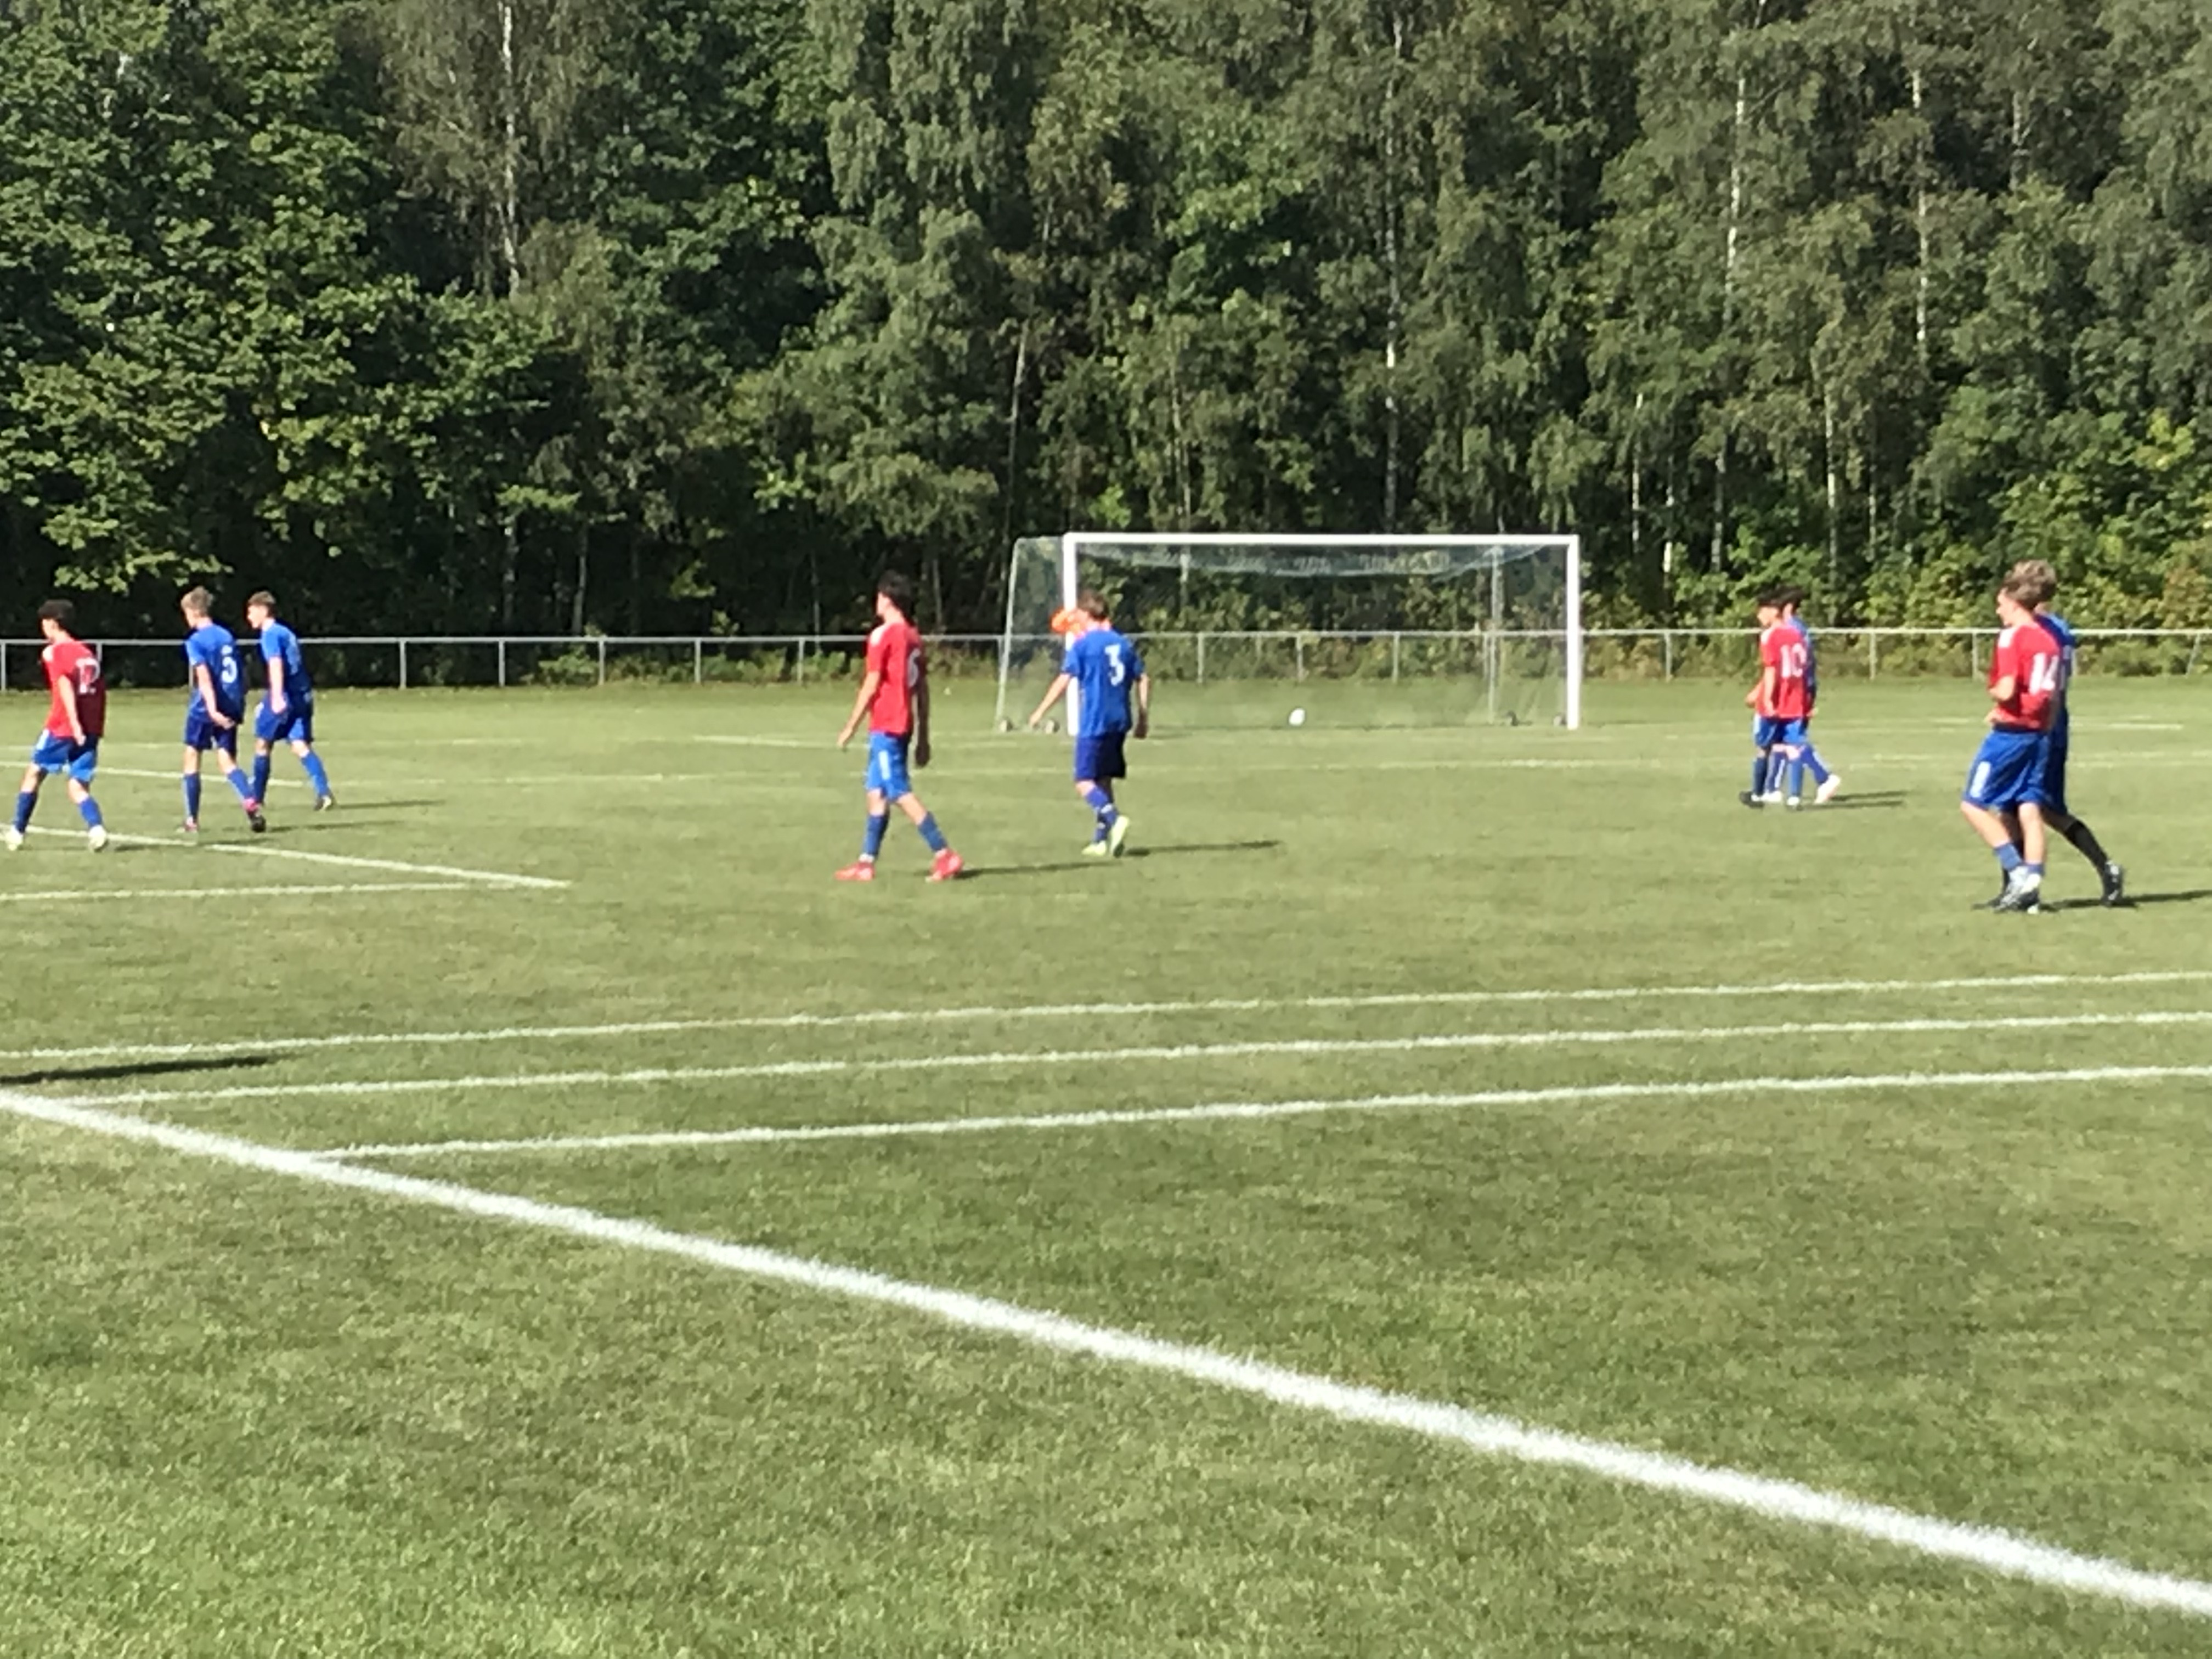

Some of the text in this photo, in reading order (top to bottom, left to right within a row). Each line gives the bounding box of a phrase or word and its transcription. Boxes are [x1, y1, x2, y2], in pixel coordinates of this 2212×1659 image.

[1104, 644, 1125, 686] 3
[1780, 643, 1807, 678] 10
[2029, 652, 2059, 695] 14
